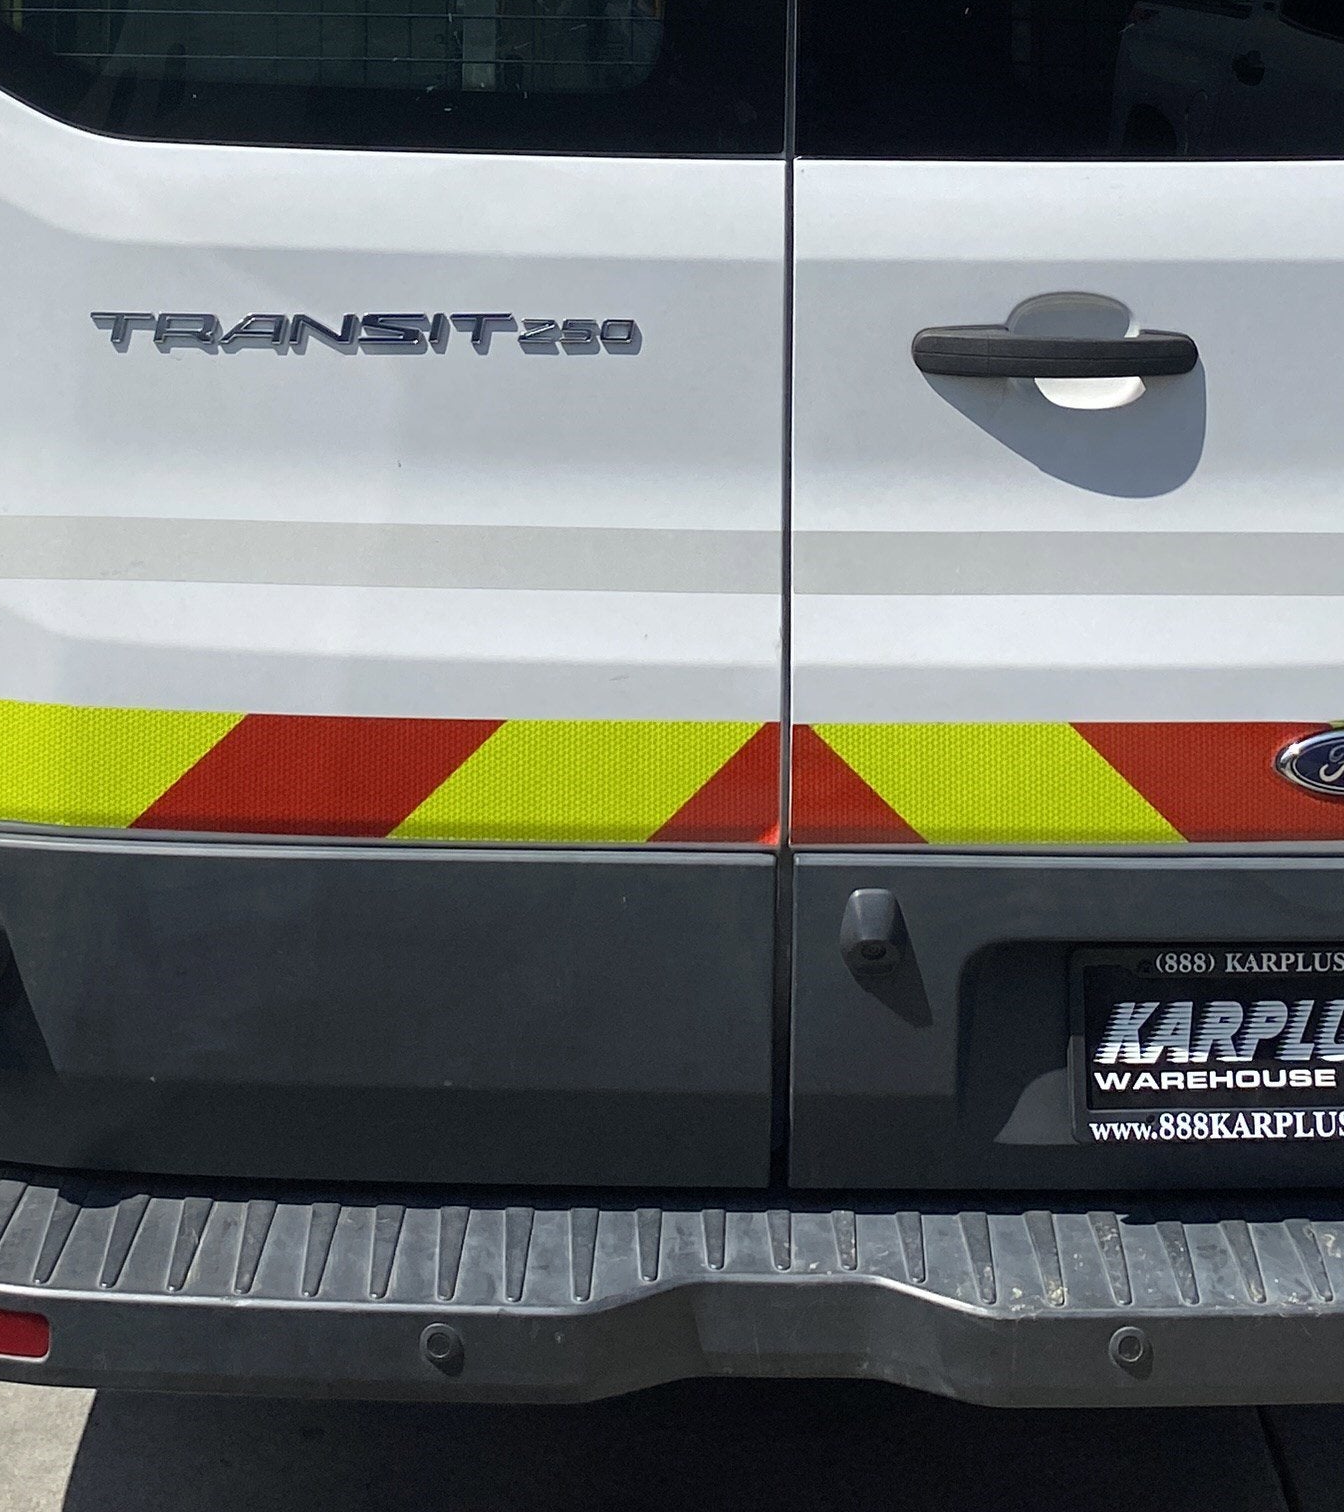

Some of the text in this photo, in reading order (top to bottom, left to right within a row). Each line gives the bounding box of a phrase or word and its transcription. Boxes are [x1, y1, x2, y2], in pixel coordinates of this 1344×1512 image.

[90, 312, 637, 345] TRANSIT 250
[1155, 953, 1216, 973] (888)
[1093, 1068, 1337, 1091] WAREHOUSE
